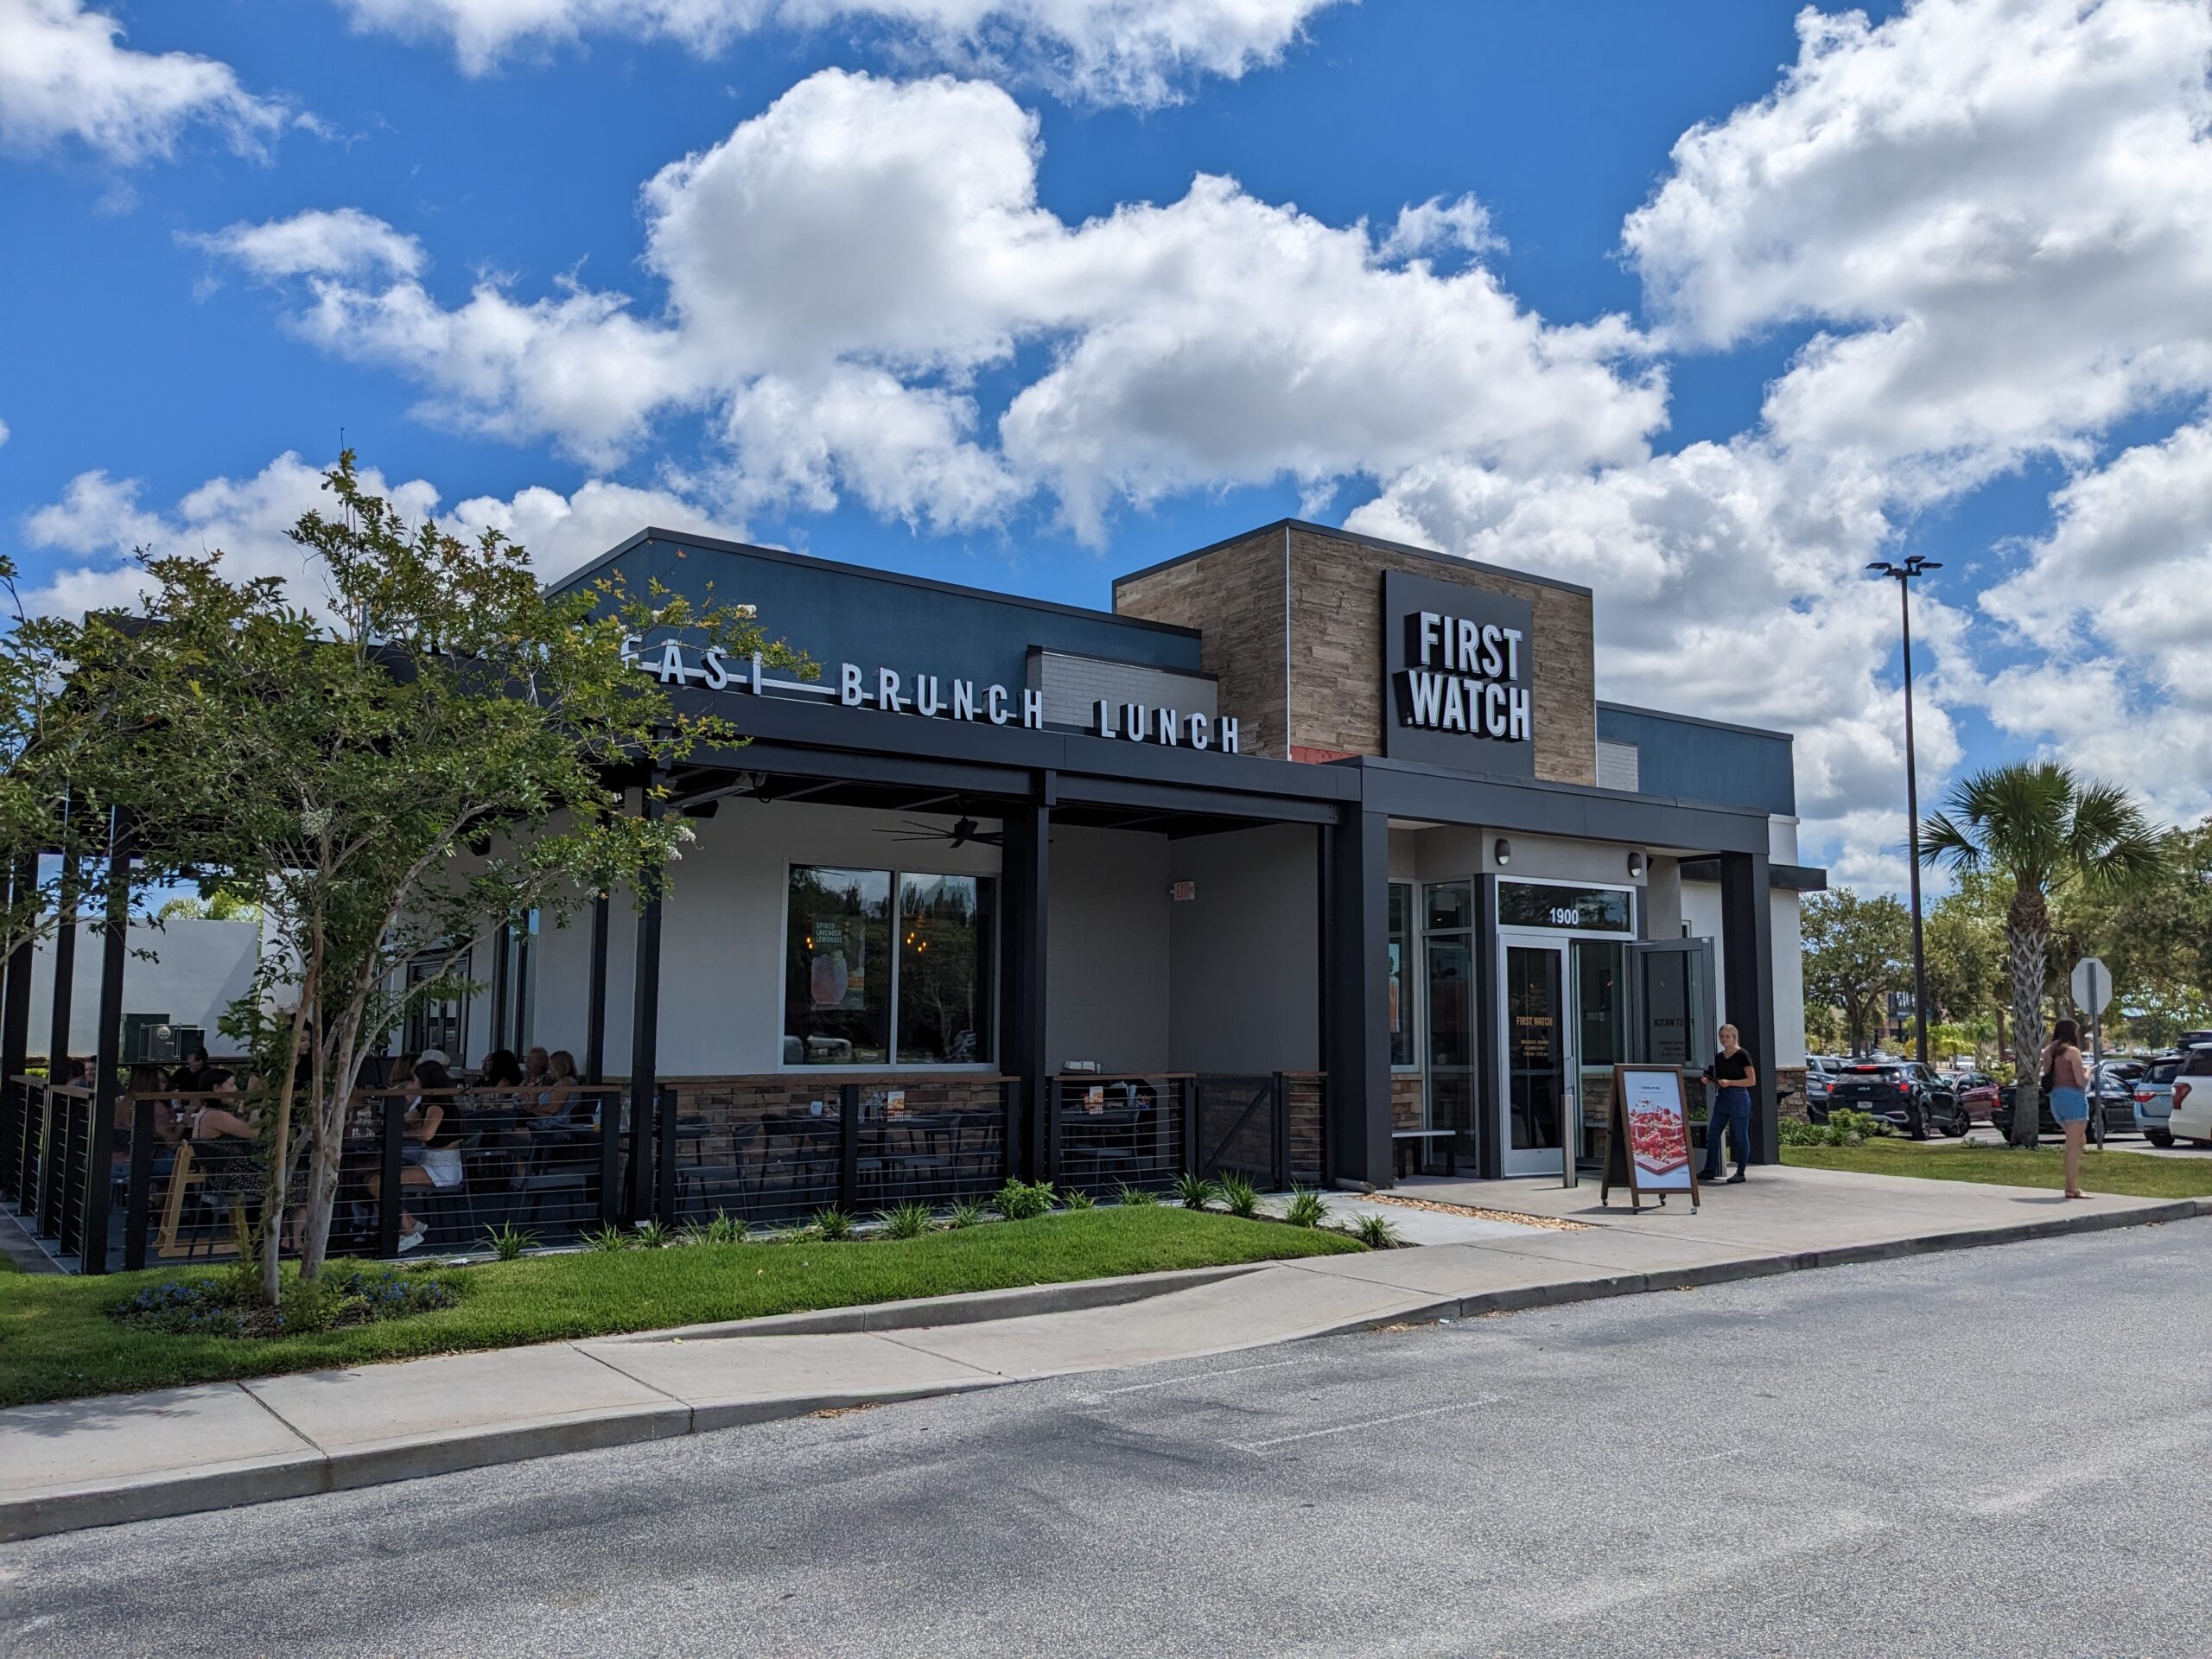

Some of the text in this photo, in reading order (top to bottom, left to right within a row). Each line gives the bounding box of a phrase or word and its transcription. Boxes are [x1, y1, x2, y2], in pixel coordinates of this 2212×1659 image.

[1420, 611, 1523, 681] FIRST
[840, 662, 1043, 729] BRUNCH
[1097, 699, 1239, 753] LUNCH
[1408, 670, 1530, 741] WATCH
[1549, 906, 1580, 925] 1900
[1516, 1016, 1553, 1027] FIRST WATCH
